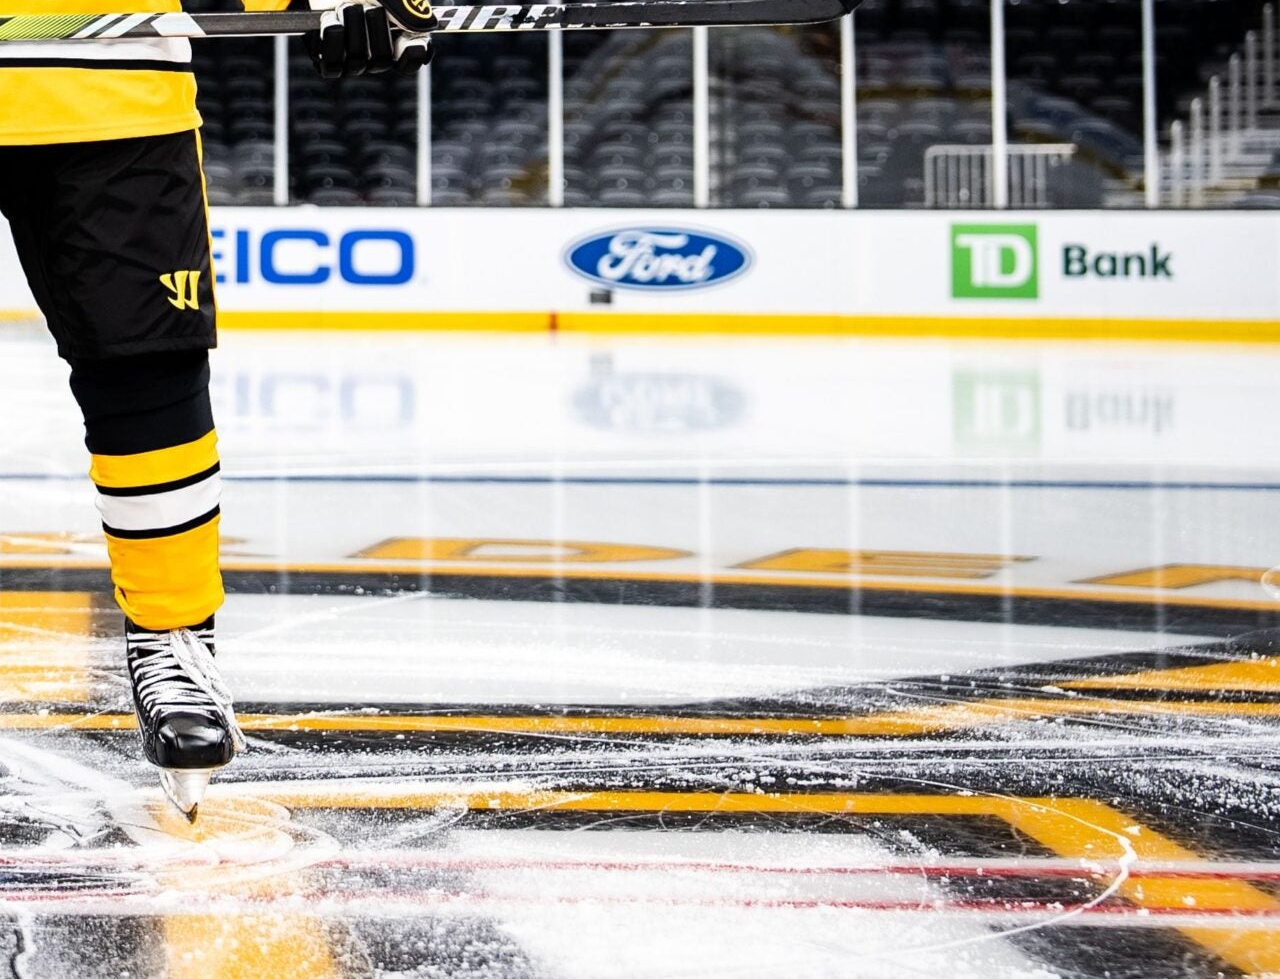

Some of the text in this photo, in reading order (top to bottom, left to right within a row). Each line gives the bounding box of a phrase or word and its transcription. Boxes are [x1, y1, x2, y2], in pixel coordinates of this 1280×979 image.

[597, 229, 717, 283] Ford
[955, 233, 1174, 287] TD Bank
